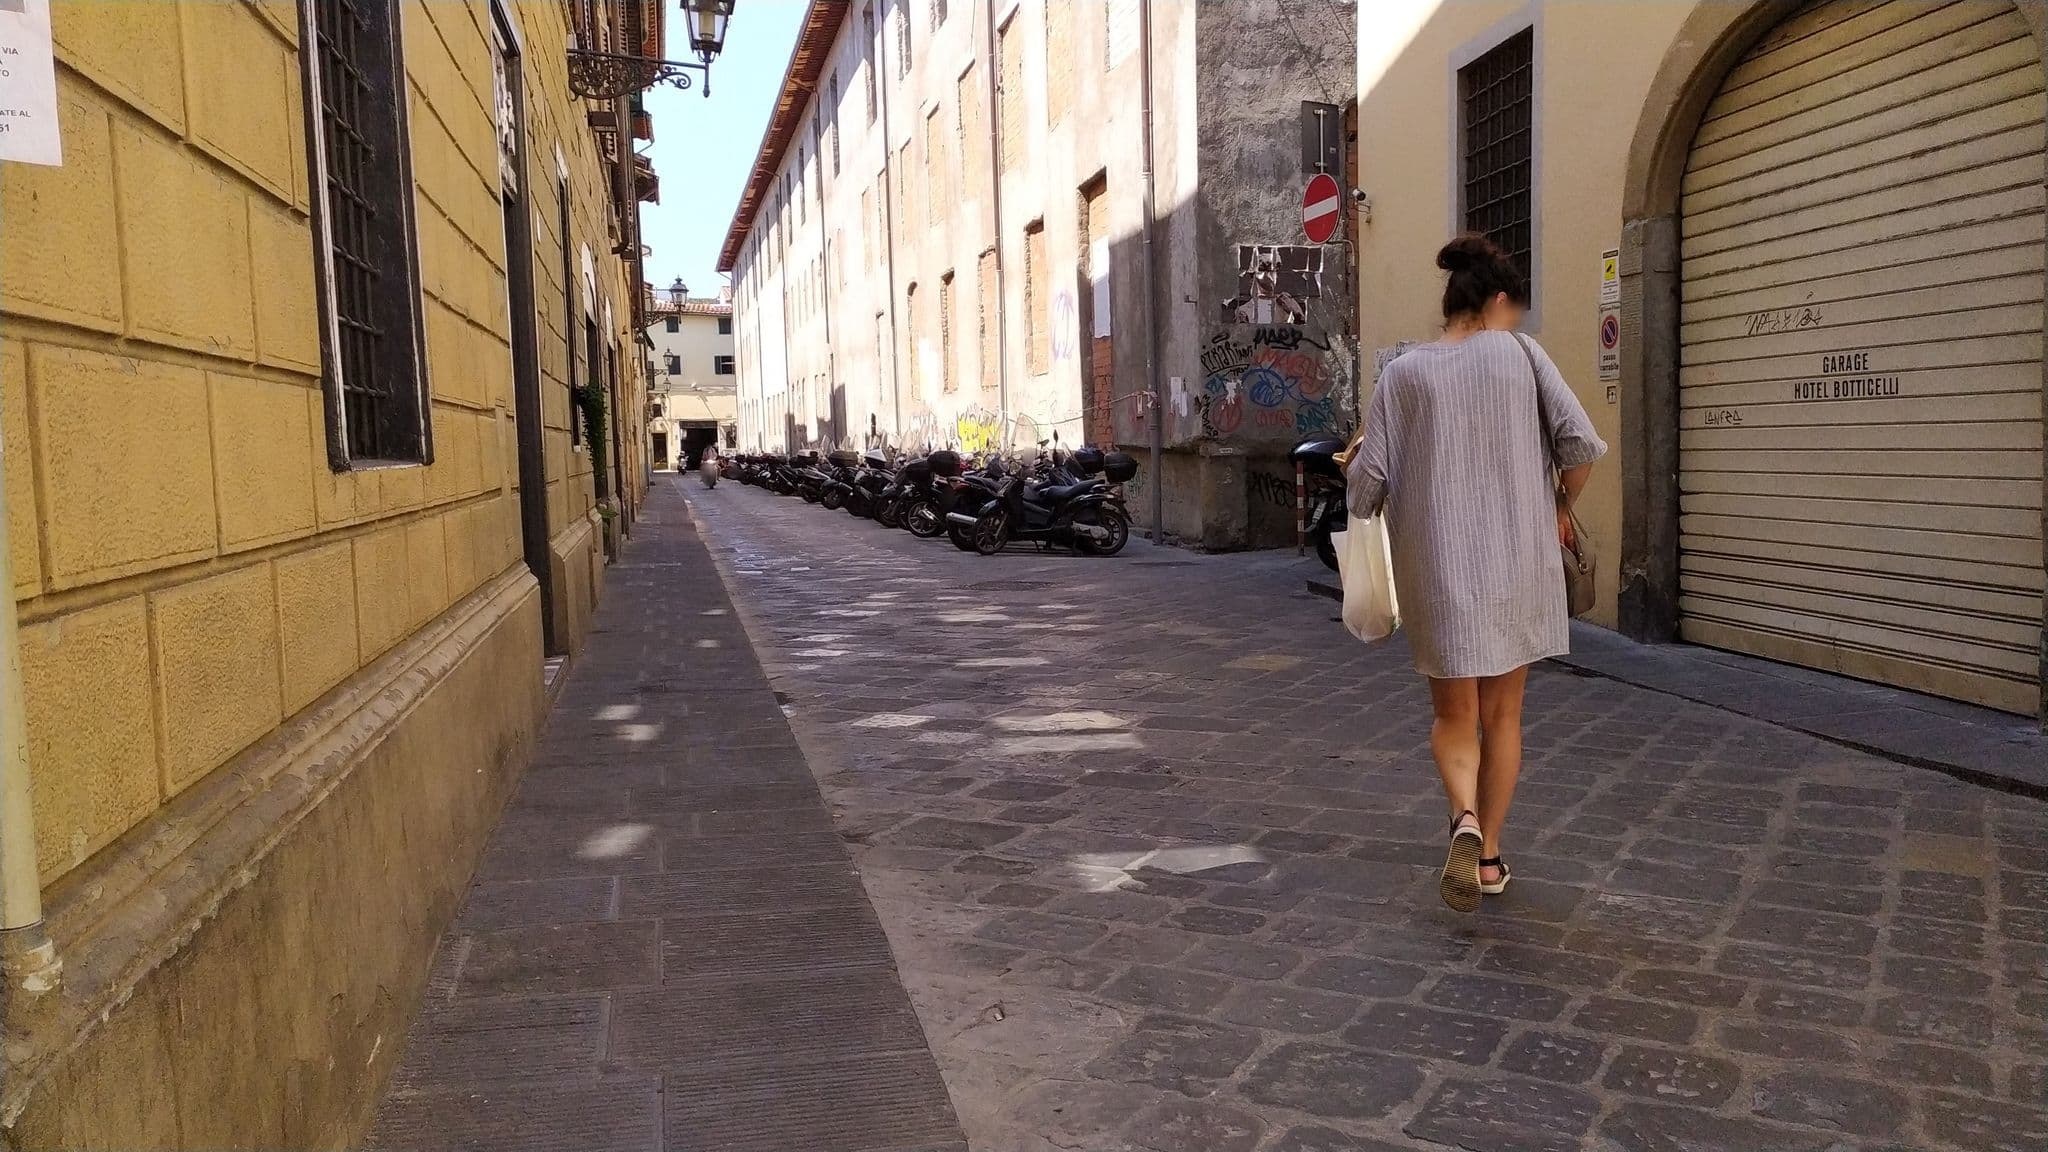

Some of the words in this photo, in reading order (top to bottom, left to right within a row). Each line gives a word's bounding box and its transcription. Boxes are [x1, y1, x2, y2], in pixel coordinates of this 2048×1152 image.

[2, 46, 19, 55] VIA
[19, 110, 31, 118] AL
[1822, 352, 1869, 373] GARAGE
[1794, 380, 1829, 399] HOTEL
[1834, 377, 1899, 398] BOTTICELLI
